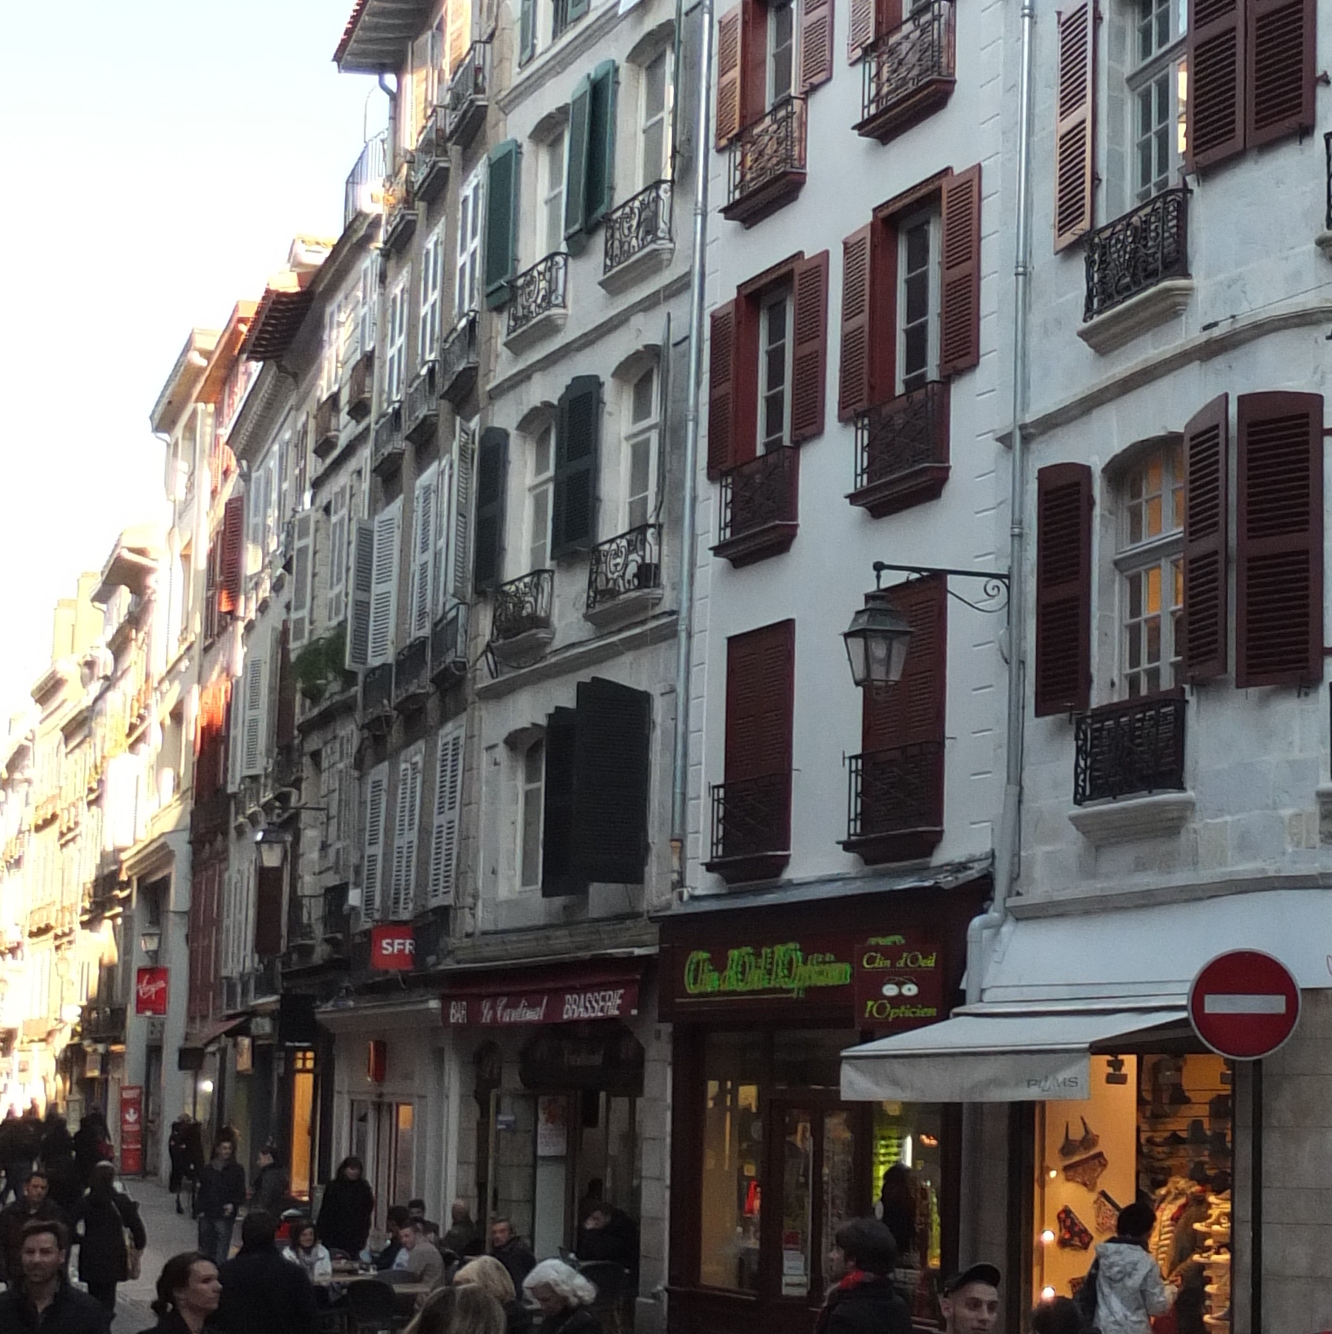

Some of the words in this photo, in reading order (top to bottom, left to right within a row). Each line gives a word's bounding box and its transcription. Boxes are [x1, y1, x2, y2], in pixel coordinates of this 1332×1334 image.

[382, 938, 416, 955] SFR
[862, 951, 891, 969] Clin
[450, 1001, 468, 1024] BAR
[562, 988, 625, 1019] BRASSERIE
